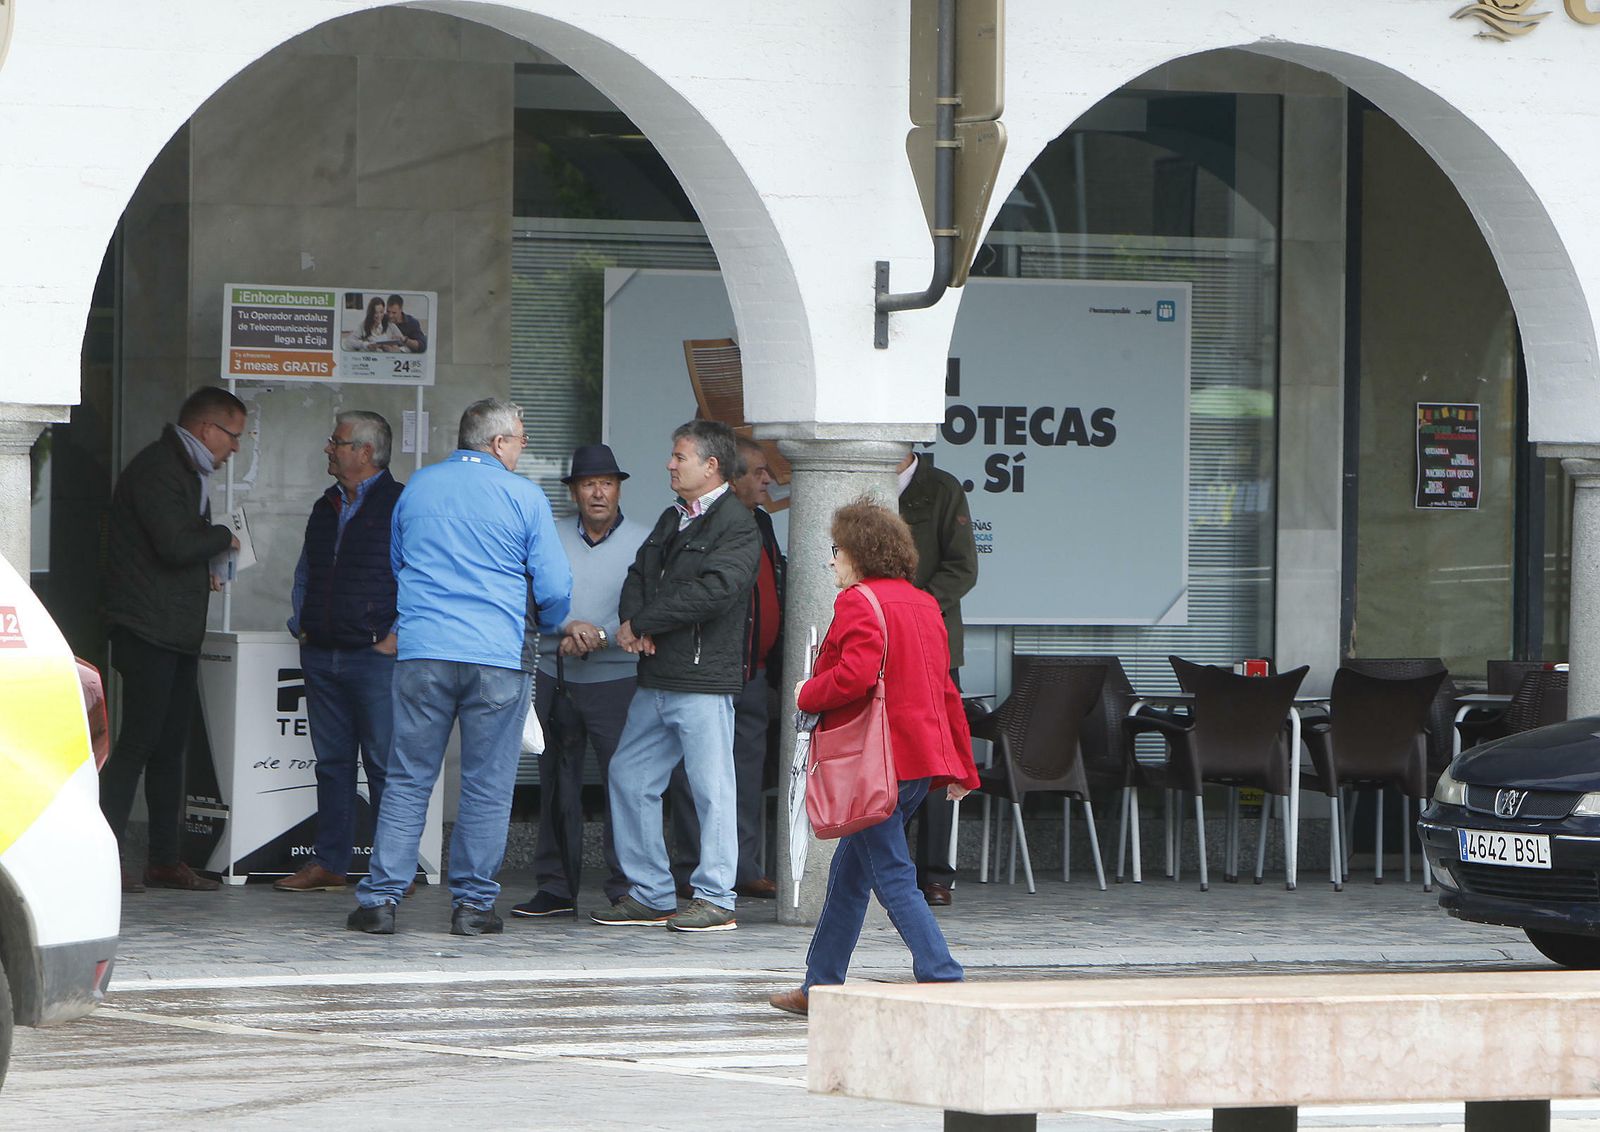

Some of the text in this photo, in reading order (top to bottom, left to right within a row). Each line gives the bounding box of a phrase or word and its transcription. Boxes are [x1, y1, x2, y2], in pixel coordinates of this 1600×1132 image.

[239, 291, 329, 305] ¡Enhorabuena!
[238, 311, 328, 322] Tu Operador andaluz
[238, 323, 328, 334] de Telecomunicaciones
[274, 335, 296, 345] llega
[305, 334, 327, 346] Écija
[234, 360, 329, 374] 3 meses GRATIS
[393, 360, 410, 373] 24
[940, 404, 1116, 447] OTECAS
[1468, 833, 1508, 861] 4642
[1514, 837, 1547, 864] BSL
